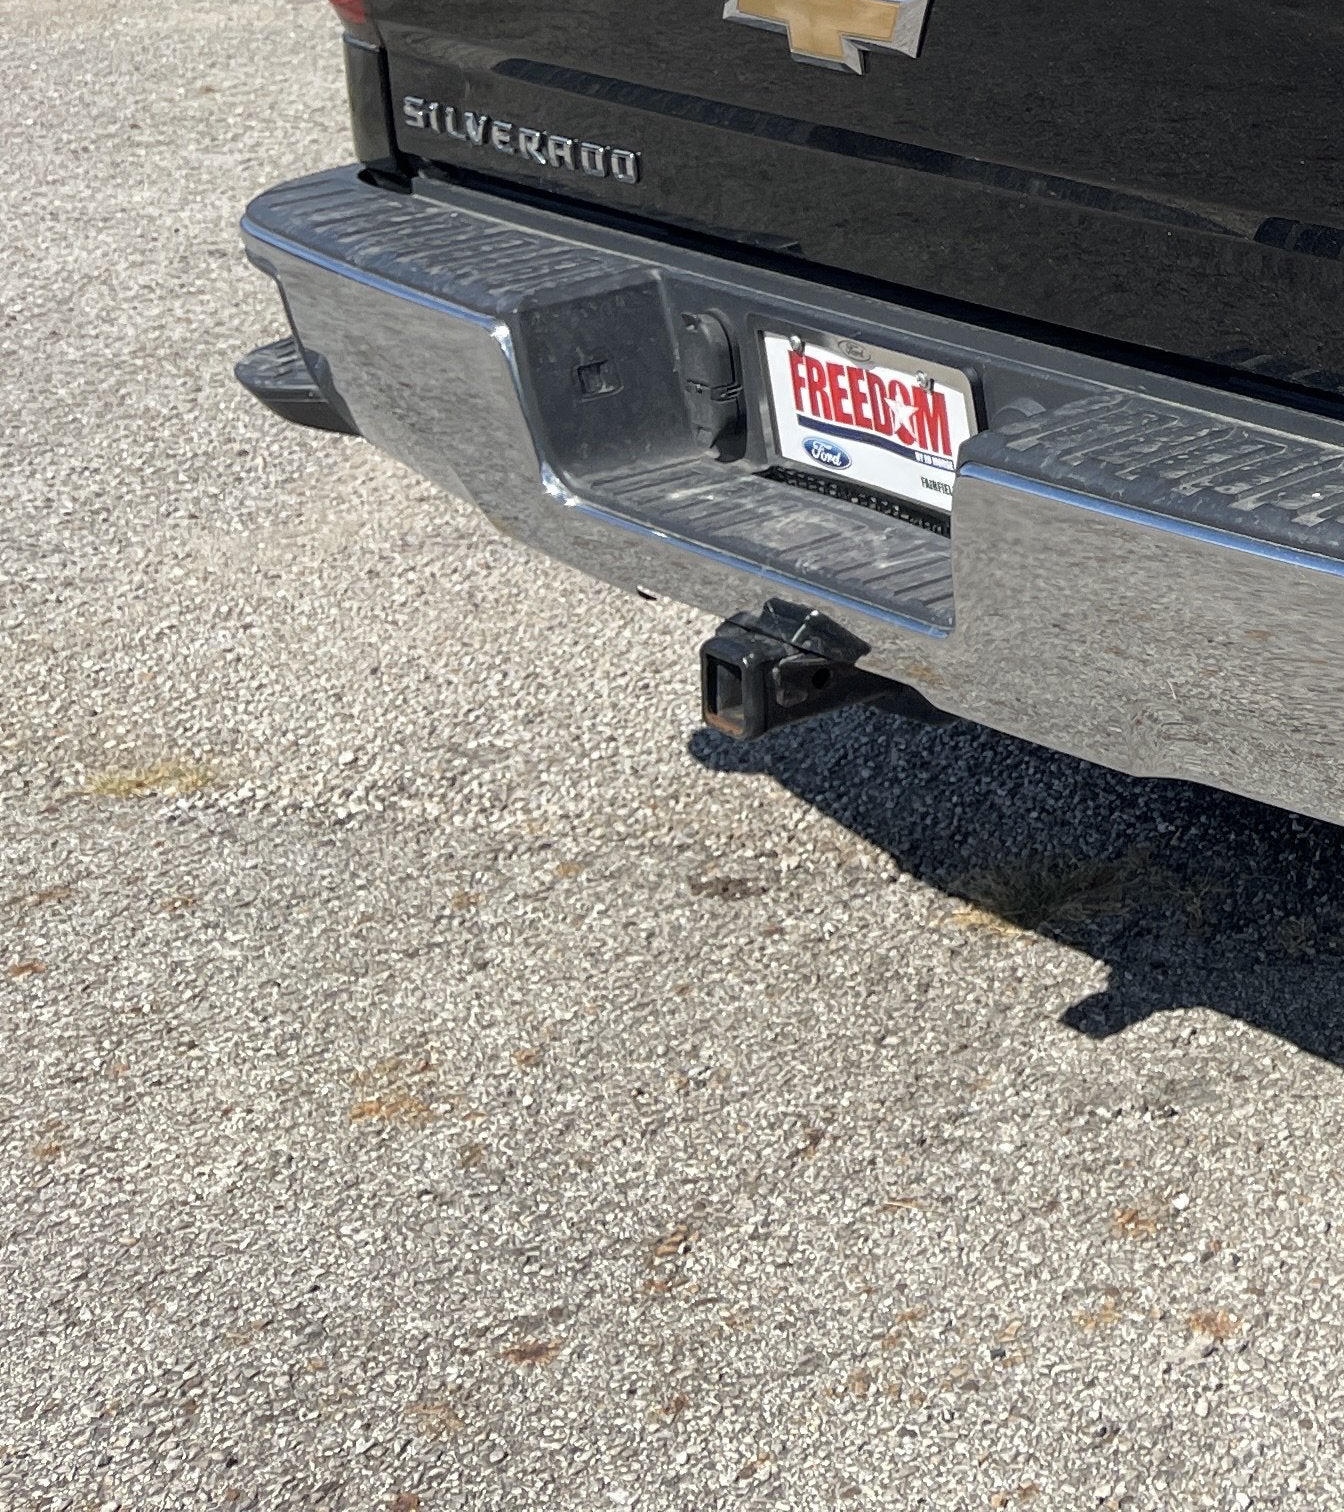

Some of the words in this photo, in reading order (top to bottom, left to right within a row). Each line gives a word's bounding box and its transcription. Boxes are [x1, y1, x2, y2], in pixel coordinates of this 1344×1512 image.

[403, 95, 642, 185] SILVERADO
[787, 349, 953, 457] FREEDOM
[810, 442, 843, 467] Ford
